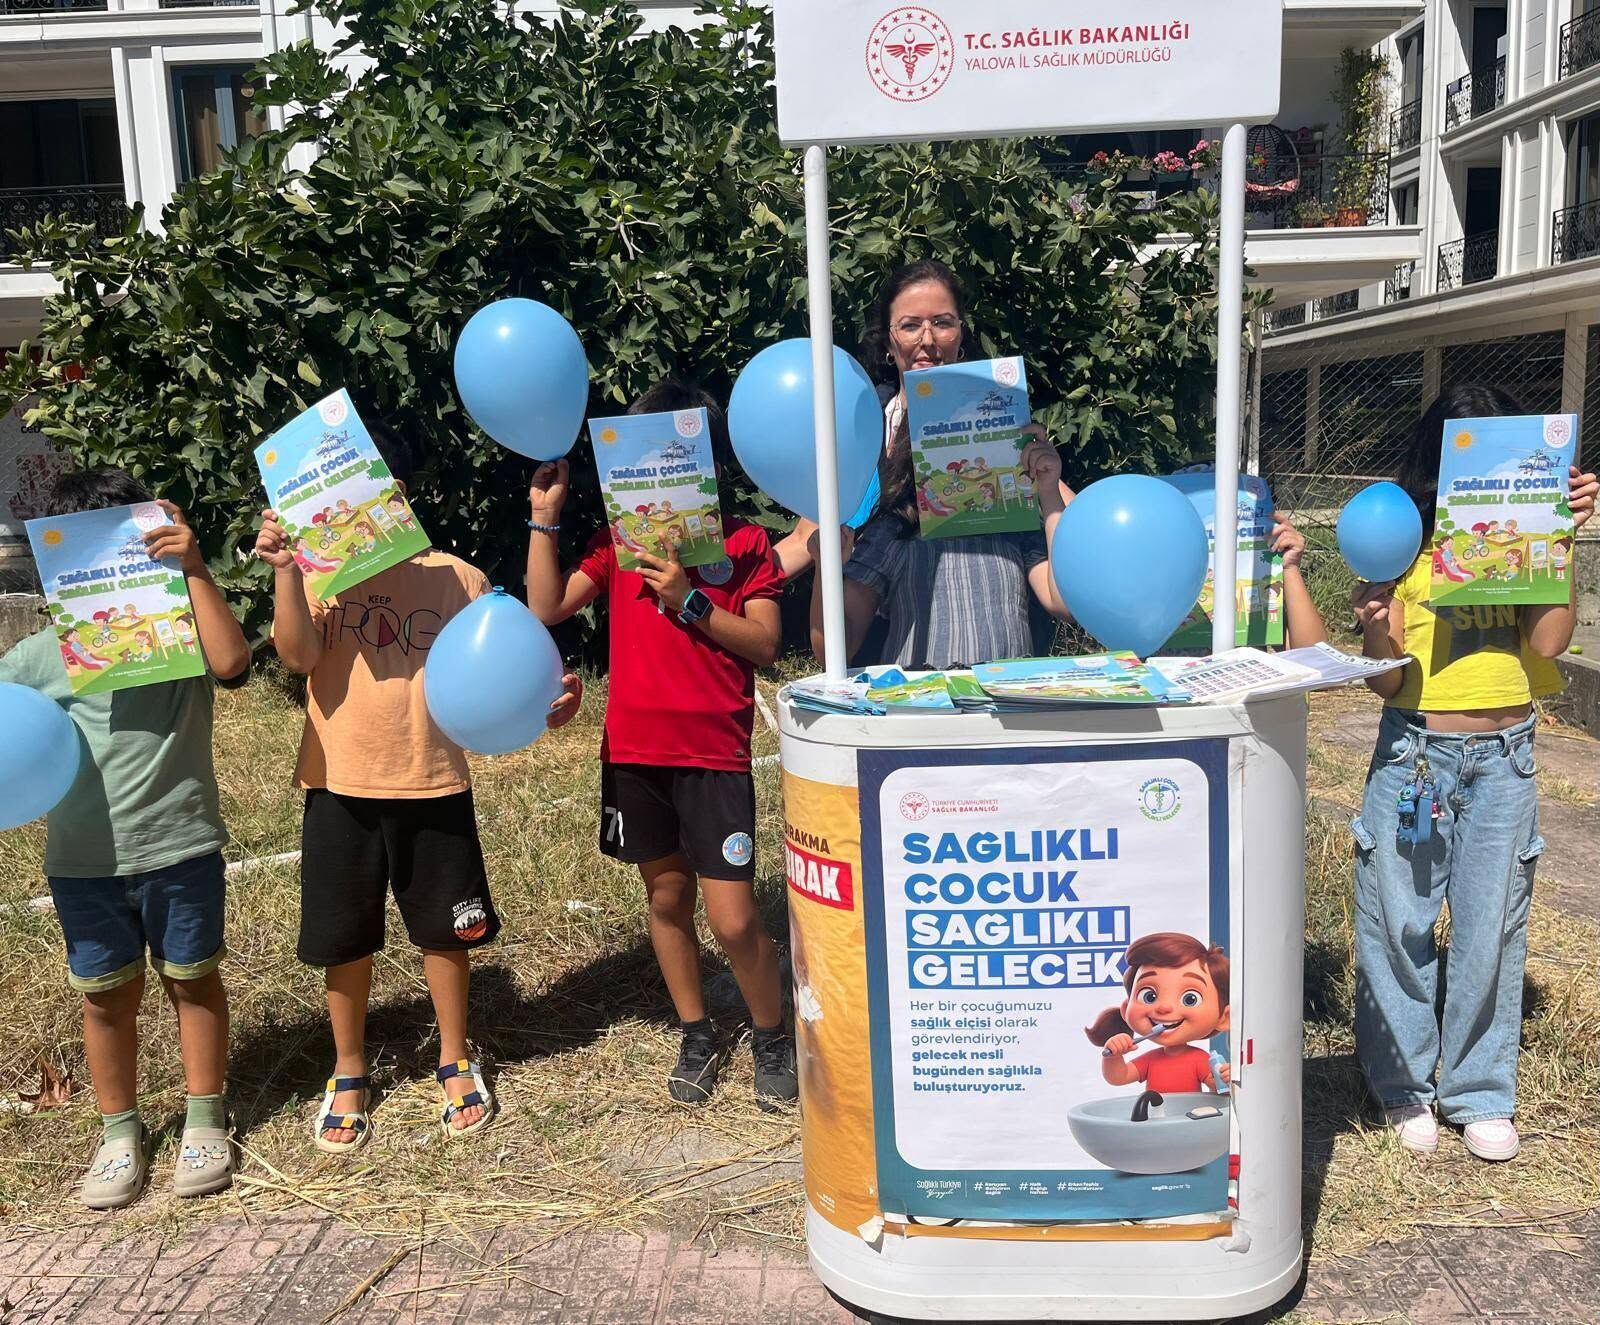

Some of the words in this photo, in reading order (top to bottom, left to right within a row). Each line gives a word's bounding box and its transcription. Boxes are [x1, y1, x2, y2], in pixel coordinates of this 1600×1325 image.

[964, 33, 997, 50] T.C.
[1001, 27, 1073, 49] SAĞLIK
[1079, 20, 1189, 45] BAKANLIĞI
[964, 56, 1016, 71] YALOVA
[1019, 53, 1030, 69] İL
[1033, 51, 1080, 68] SAĞLIK
[1083, 46, 1172, 65] MÜDÜRLÜĞÜ
[975, 415, 1016, 431] ÇOCUK
[320, 447, 361, 475] ÇOCUK
[660, 462, 699, 478] ÇOCUK
[1453, 478, 1510, 491] SAĞLIKLI
[1513, 477, 1559, 491] ÇOCUK
[368, 595, 392, 605] KEEP
[452, 900, 468, 912] CITY
[912, 951, 1126, 986] GELECEK
[910, 1000, 934, 1011] Her
[938, 1000, 957, 1011] bir
[960, 1000, 1053, 1014] çocuğumuzu
[910, 1016, 951, 1029] sağlık
[954, 1016, 991, 1029] elçisi
[994, 1016, 1038, 1028] olarak
[911, 1033, 1021, 1046] görevlendiriyor,
[911, 1049, 967, 1062] gelecek
[970, 1048, 1004, 1060] nesli
[912, 1065, 985, 1078] bugünden
[987, 1065, 1043, 1078] sağlıkla
[913, 1081, 1026, 1094] buluşturuyoruz.
